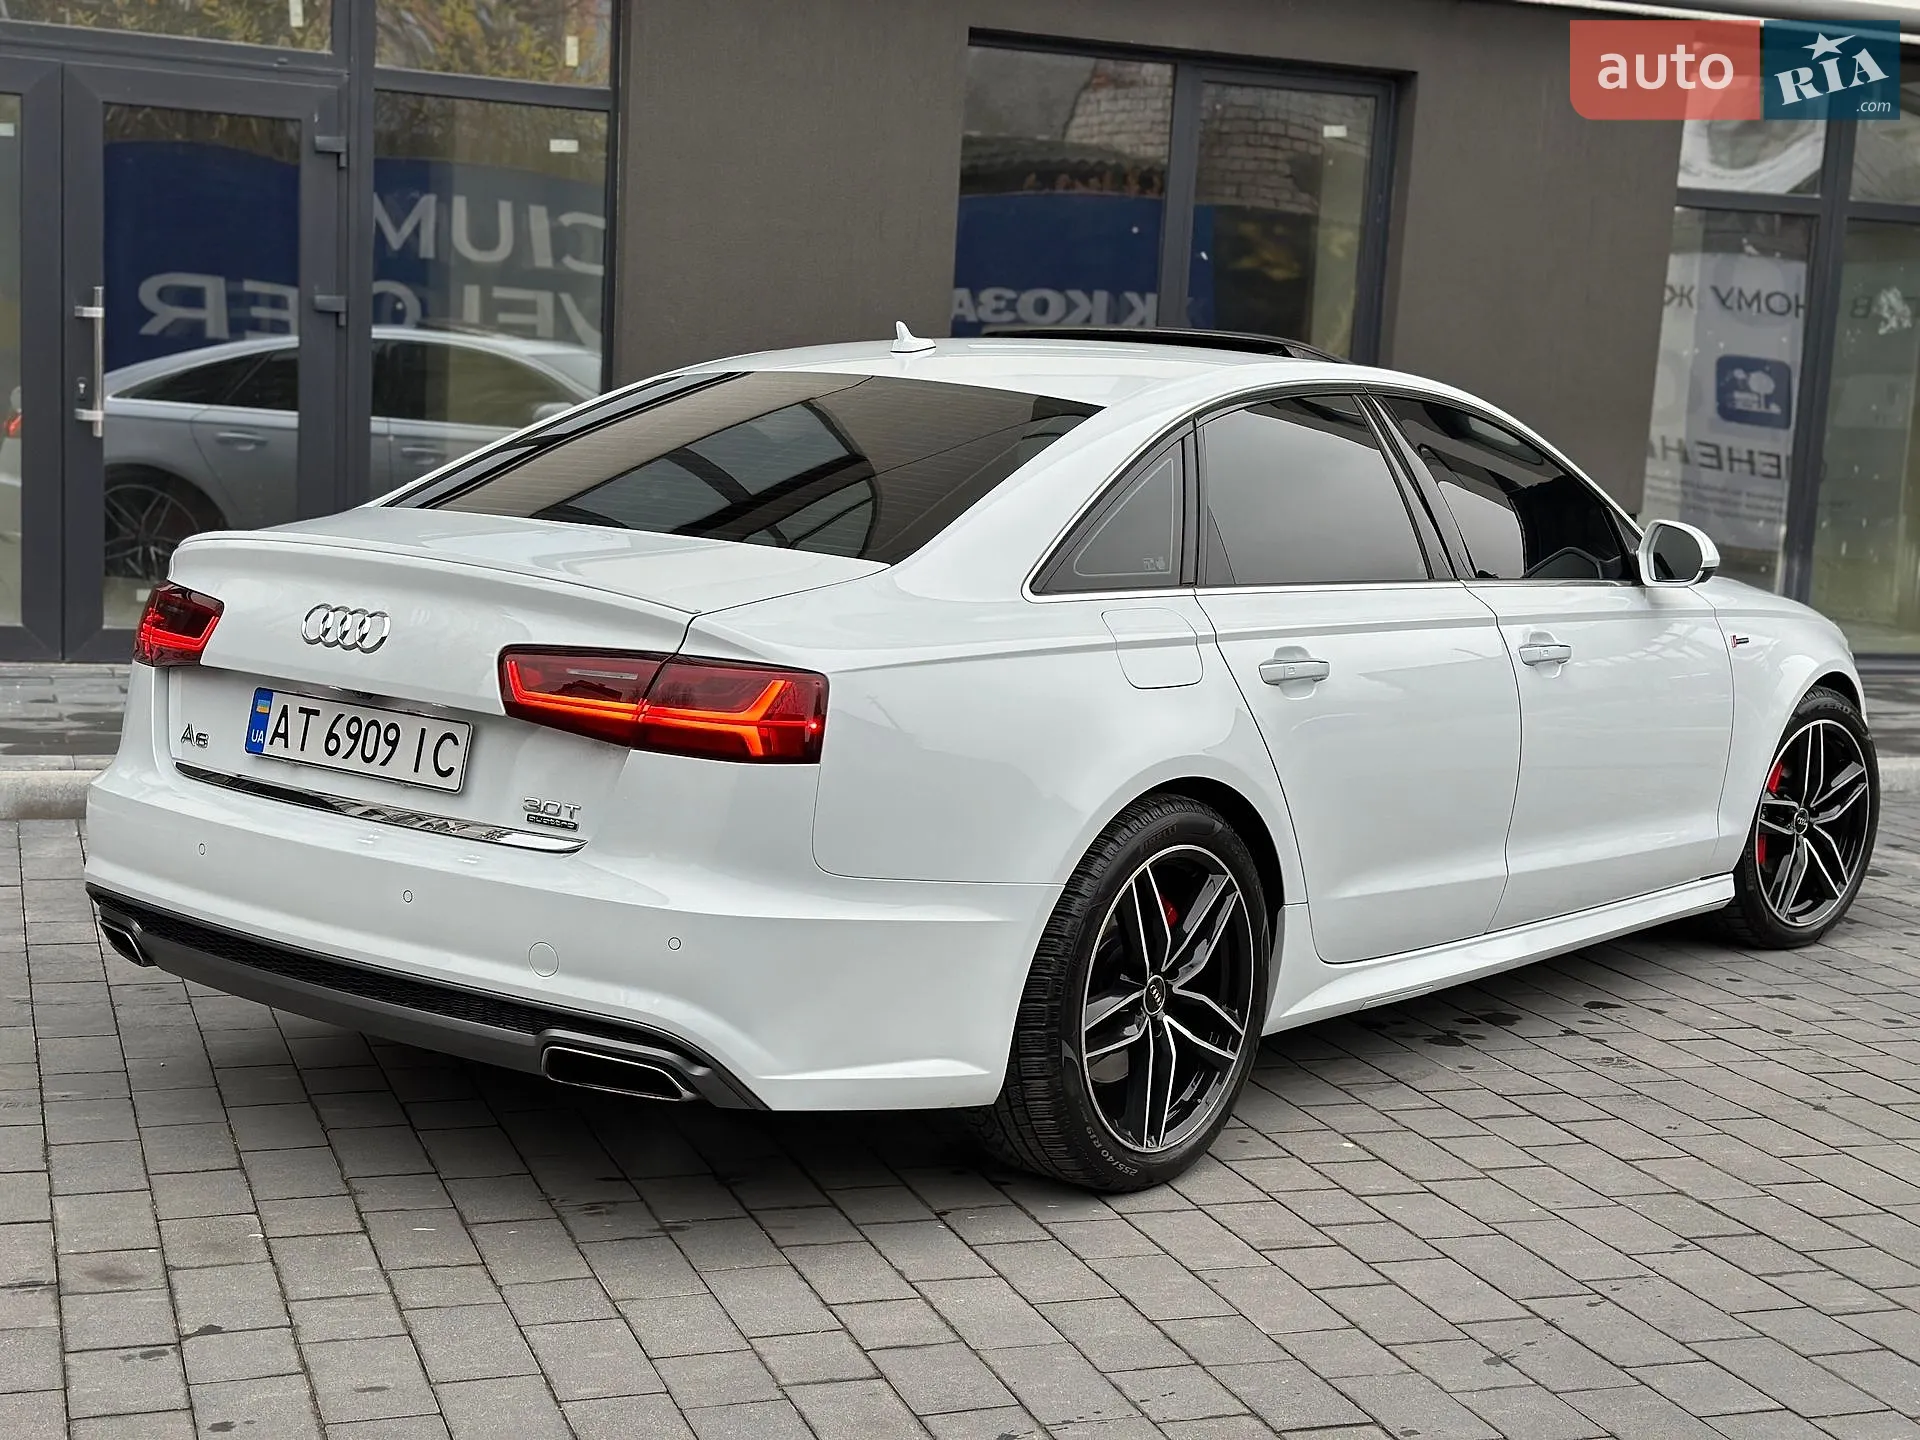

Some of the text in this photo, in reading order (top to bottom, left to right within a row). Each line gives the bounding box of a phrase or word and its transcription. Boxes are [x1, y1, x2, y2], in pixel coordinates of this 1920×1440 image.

[180, 723, 209, 748] A6
[251, 728, 265, 744] UA
[269, 704, 460, 778] AT 6909 IC
